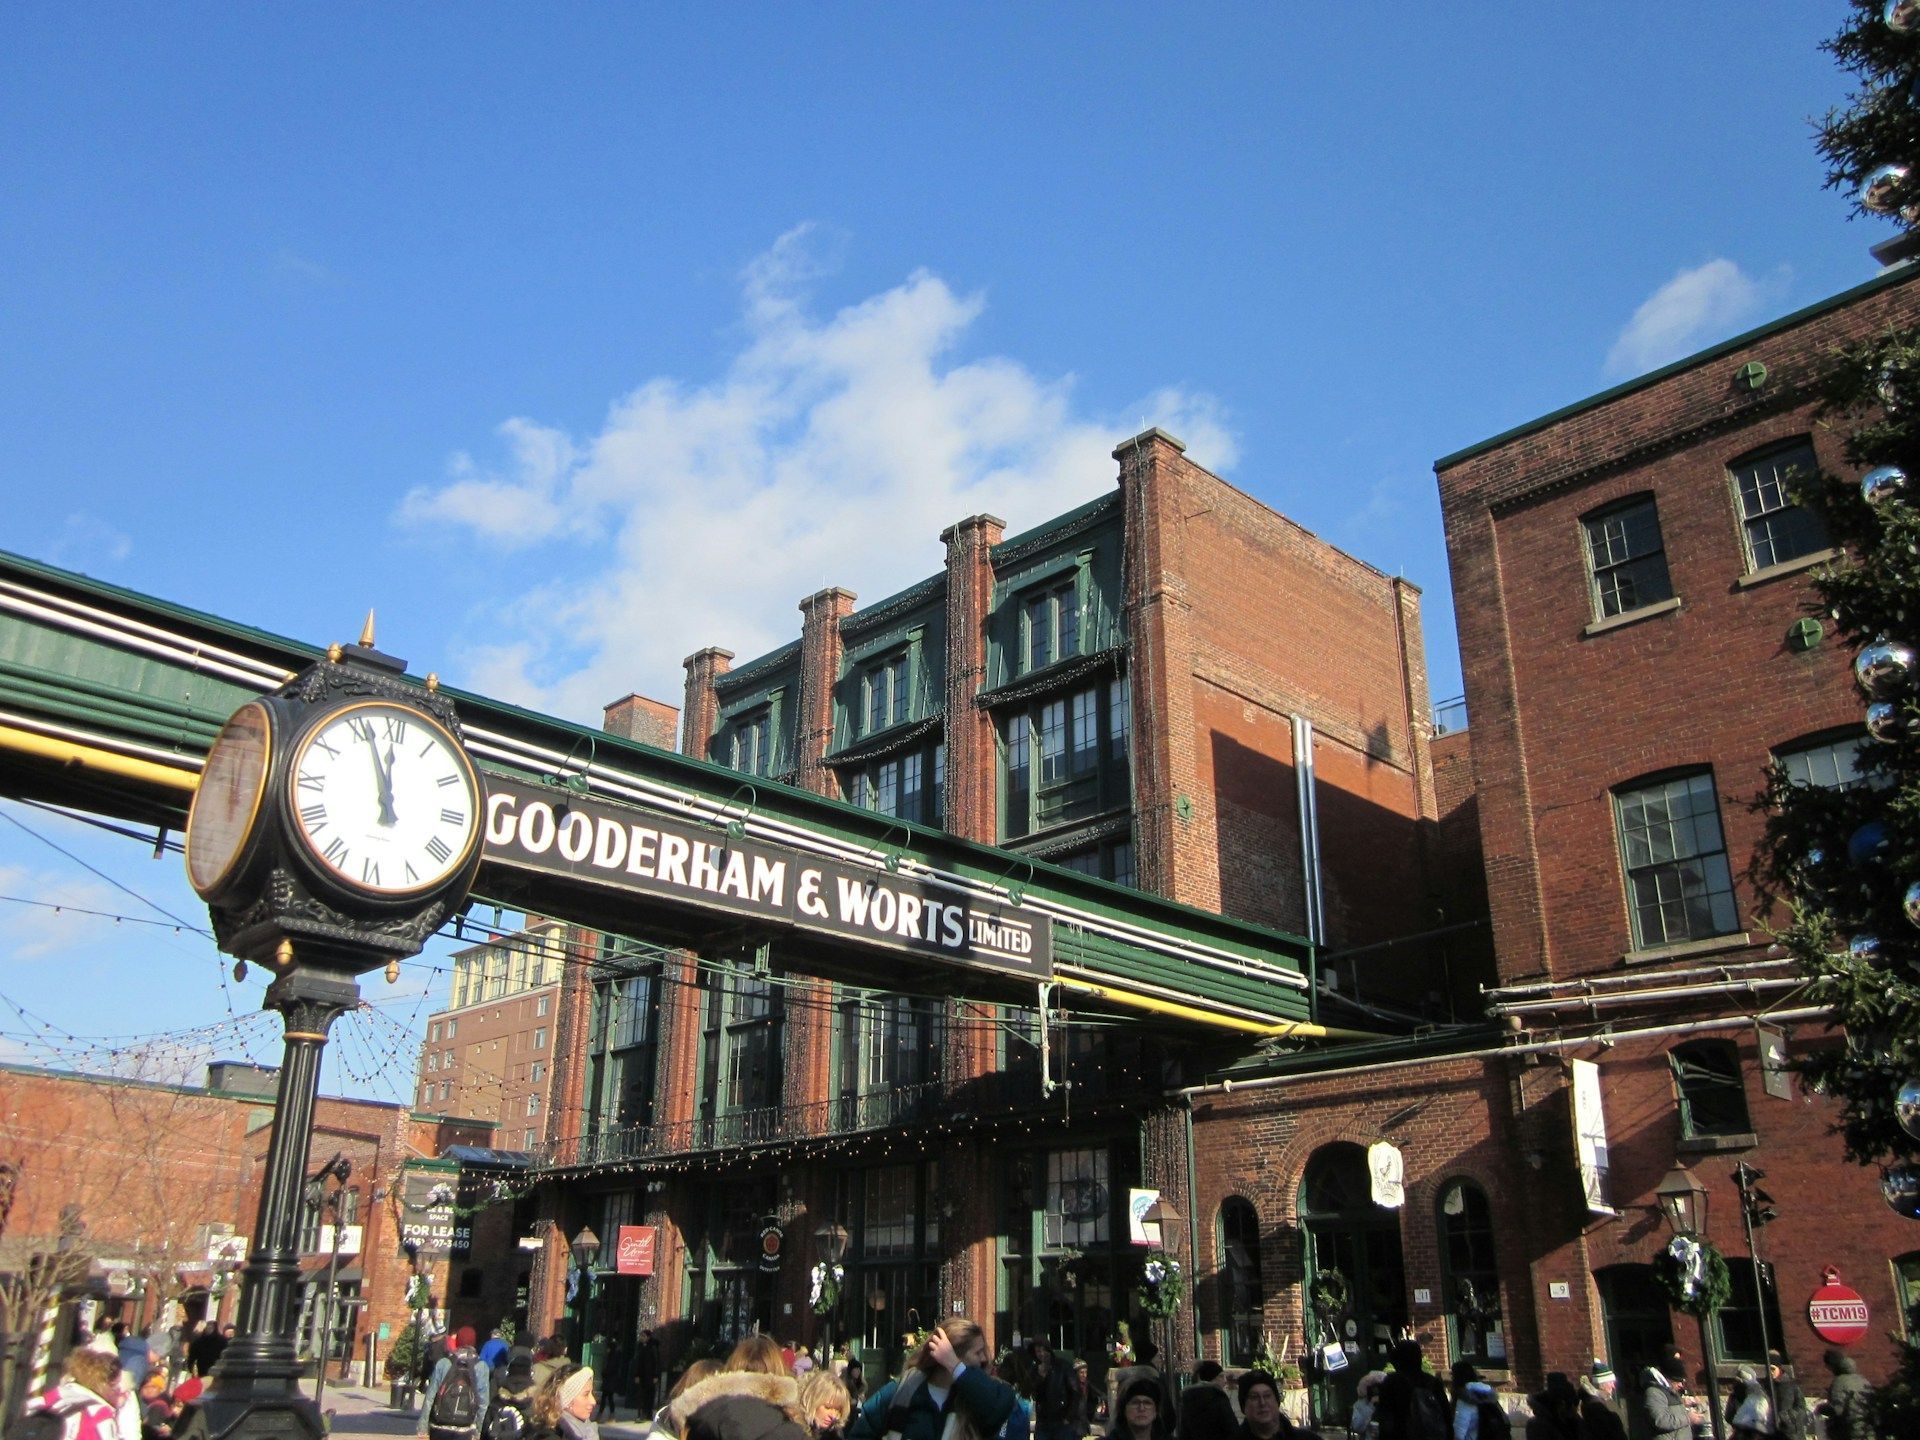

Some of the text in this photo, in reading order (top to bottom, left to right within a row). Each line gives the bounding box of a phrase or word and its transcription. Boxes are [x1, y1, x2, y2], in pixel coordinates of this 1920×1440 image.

[345, 717, 368, 744] XI
[382, 716, 407, 744] XII
[314, 735, 340, 761] X
[419, 741, 435, 758] I
[298, 770, 325, 792] IX
[437, 774, 460, 787] II
[301, 804, 328, 835] VIII
[440, 808, 464, 825] III
[323, 837, 349, 869] VII
[425, 836, 452, 864] IIII
[362, 857, 380, 885] VI
[405, 860, 420, 884] V
[485, 793, 1032, 954] GOODERHAM & WORTS LIMITED
[403, 1224, 471, 1239] FOR LEASE
[1559, 1285, 1566, 1295] 9
[1810, 1307, 1867, 1320] #TCM19
